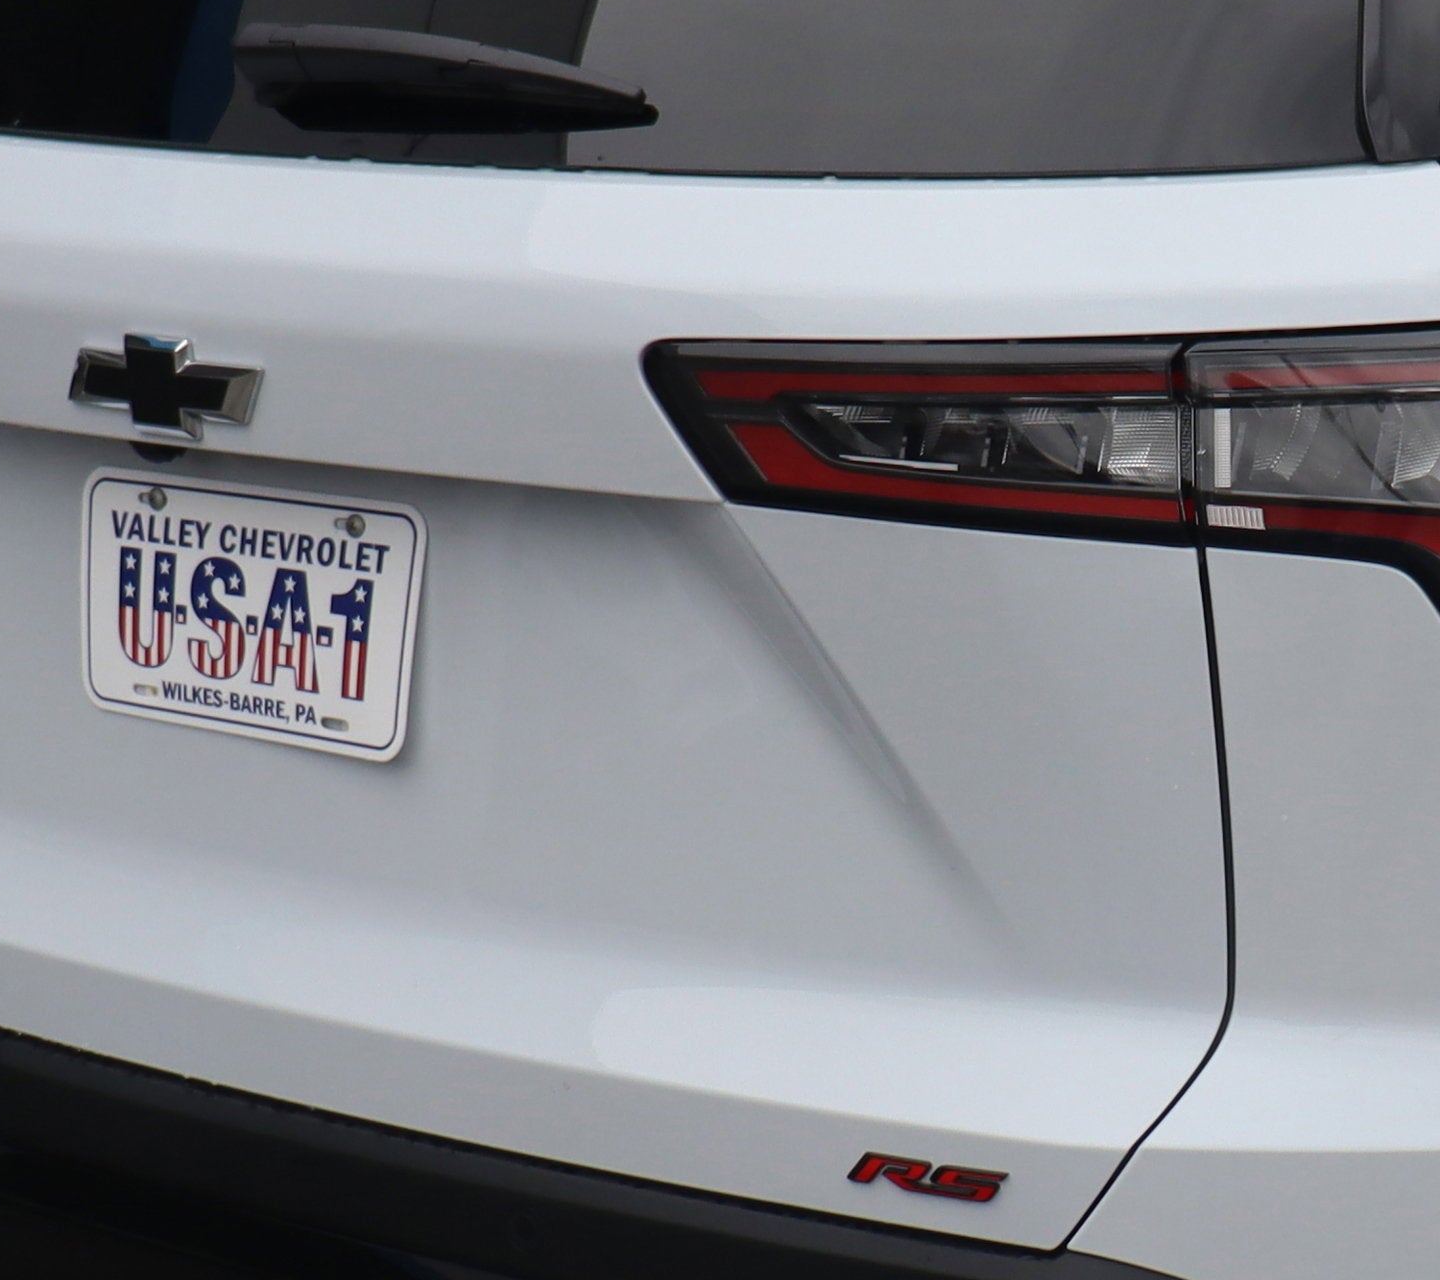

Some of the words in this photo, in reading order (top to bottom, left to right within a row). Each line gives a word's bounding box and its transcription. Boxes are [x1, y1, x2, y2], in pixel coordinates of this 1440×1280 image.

[111, 509, 213, 550] VALLEY
[219, 523, 391, 575] CHEVROLET
[161, 680, 290, 724] WILKES-BARRE,
[294, 704, 317, 726] PA
[846, 1150, 1011, 1204] RS
